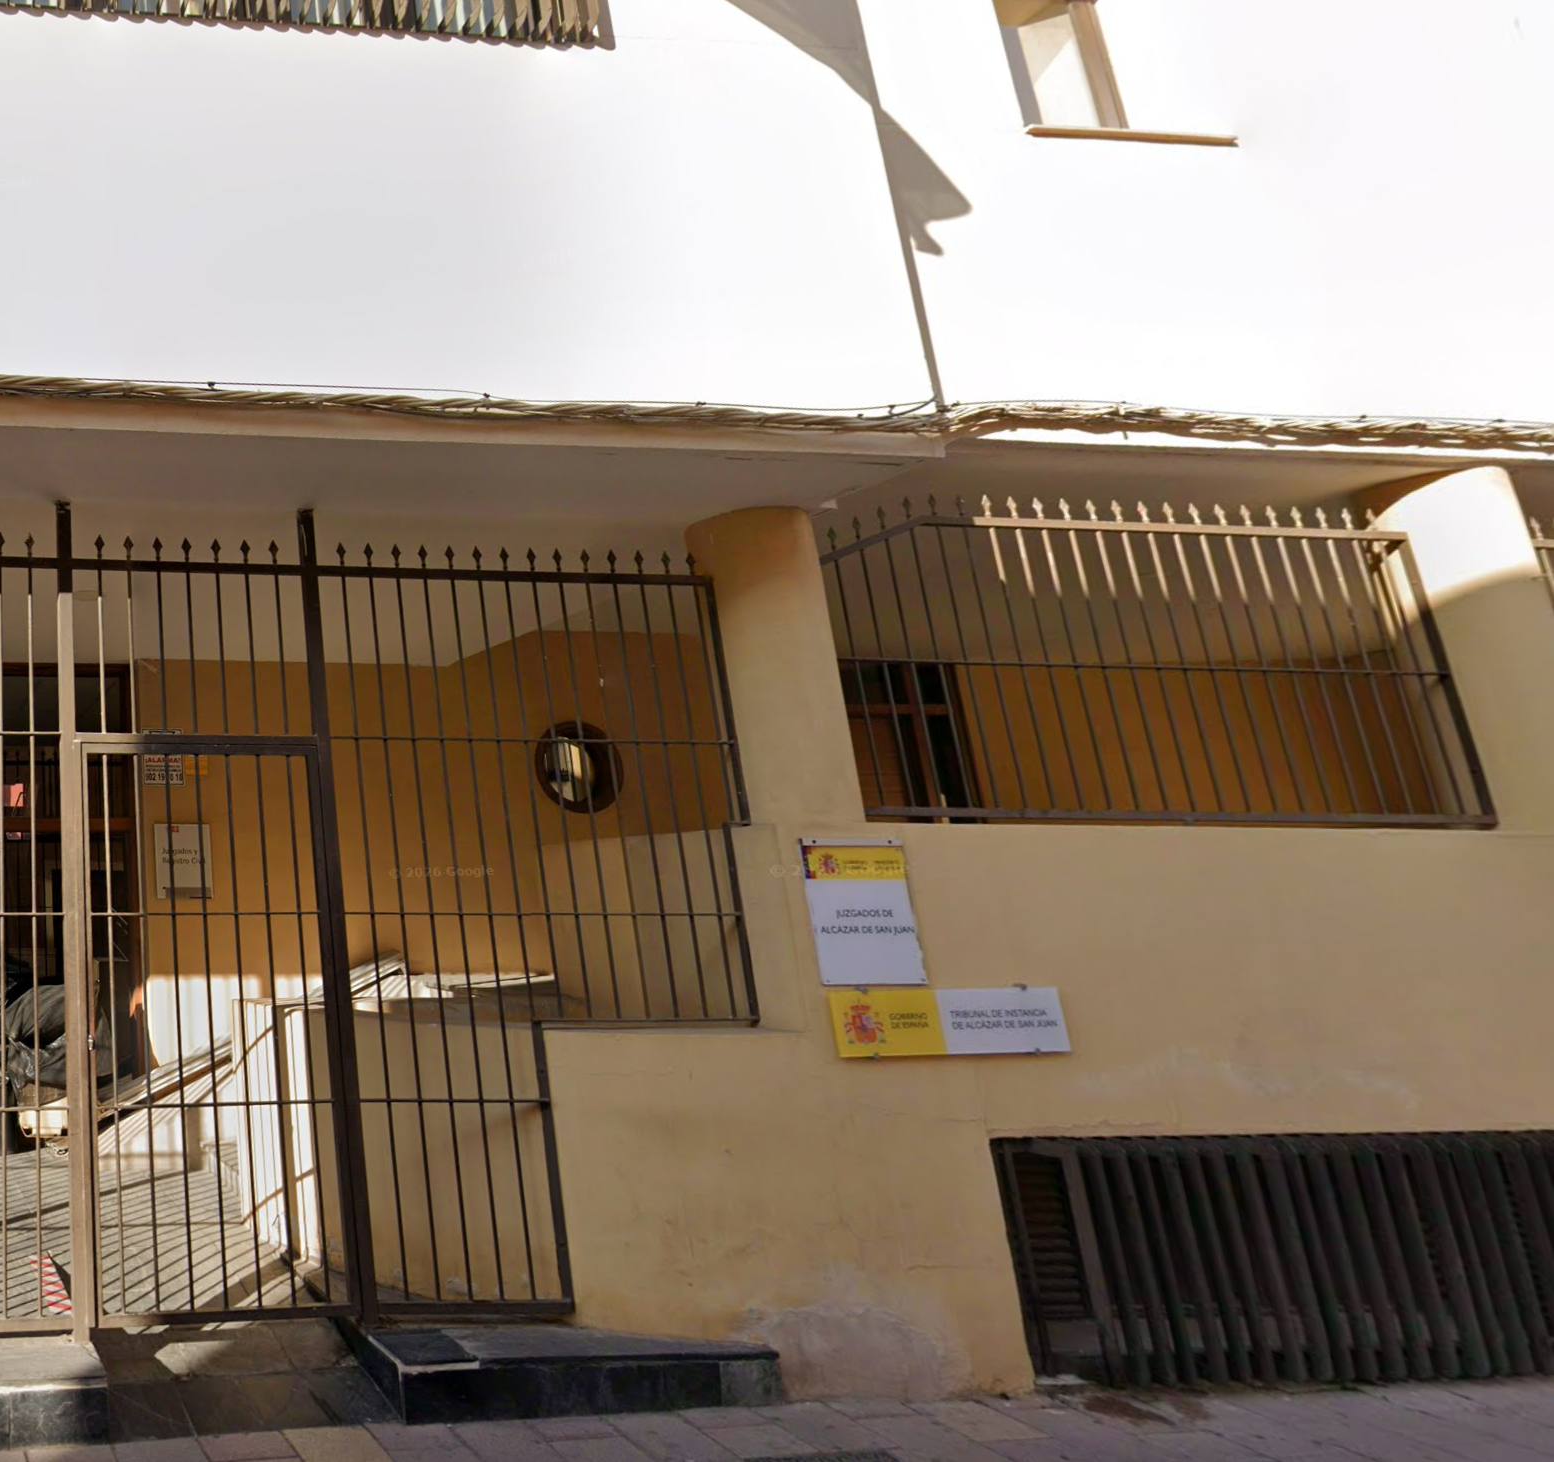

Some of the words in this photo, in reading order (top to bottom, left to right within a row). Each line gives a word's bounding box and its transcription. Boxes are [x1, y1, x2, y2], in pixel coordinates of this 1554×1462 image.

[162, 848, 192, 856] Jugados
[836, 909, 881, 919] JUZGADOS
[882, 909, 894, 918] DE
[820, 924, 860, 934] ALCÁZAR
[861, 925, 873, 934] DE
[874, 925, 892, 934] SAN
[893, 925, 915, 936] JUAN
[949, 1009, 991, 1019] TRIBUNAL
[992, 1009, 1003, 1018] DE
[1004, 1008, 1048, 1018] INSTANCIA
[891, 1021, 901, 1029] DE
[951, 1020, 964, 1030] DE
[1004, 1020, 1016, 1029] DE
[1017, 1019, 1034, 1029] SAN
[1035, 1019, 1058, 1028] JUAN
